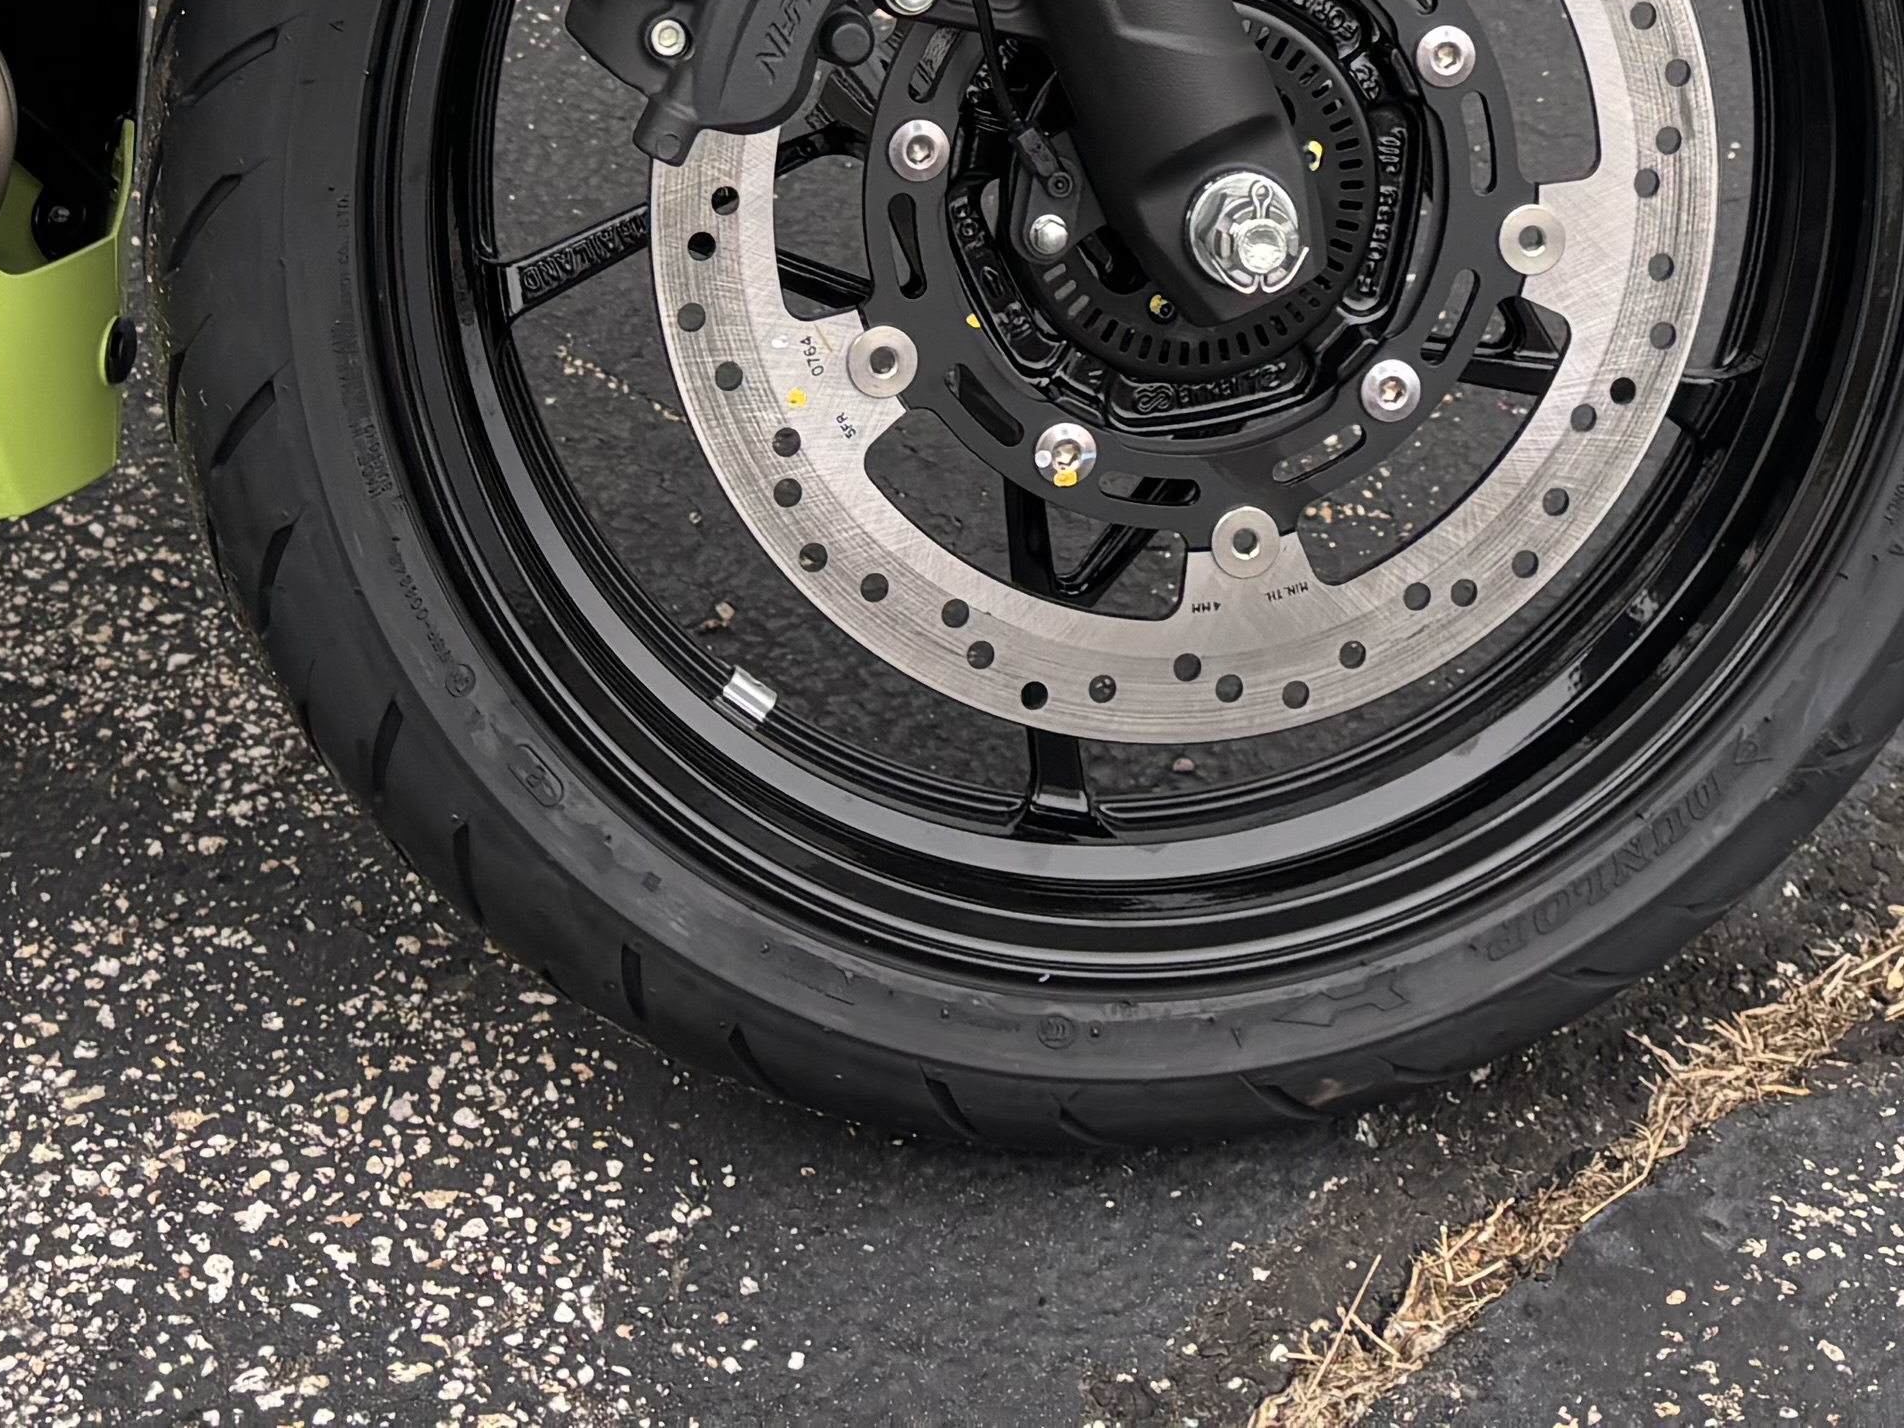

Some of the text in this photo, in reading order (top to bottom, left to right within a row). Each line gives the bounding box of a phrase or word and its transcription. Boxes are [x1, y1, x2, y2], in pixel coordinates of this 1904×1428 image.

[798, 335, 824, 376] 0764
[1191, 602, 1222, 615] 4MM
[1486, 772, 1724, 963] DUNLOP
